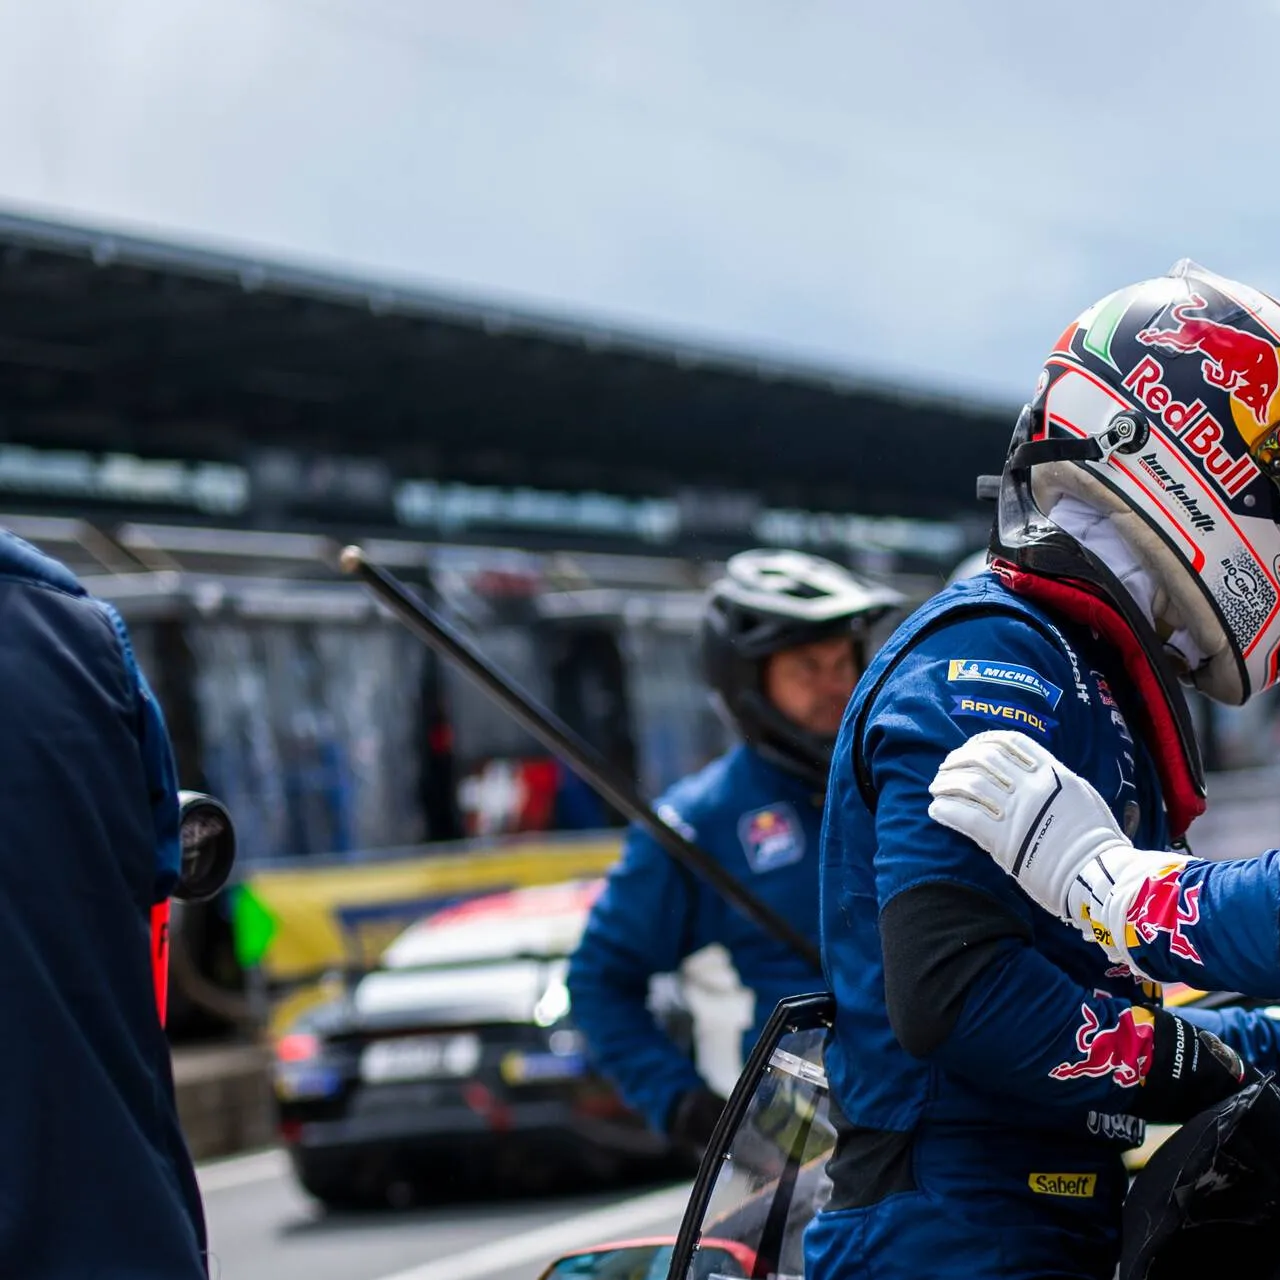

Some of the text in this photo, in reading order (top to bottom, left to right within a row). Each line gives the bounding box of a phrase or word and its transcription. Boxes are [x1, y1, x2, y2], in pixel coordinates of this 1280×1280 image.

[1122, 355, 1262, 498] Red Bull
[1221, 558, 1259, 609] BIO-CIRCLE
[984, 667, 1050, 698] MICHELIN
[961, 700, 1046, 732] RAVENOL
[1036, 1174, 1092, 1196] Sabelt
